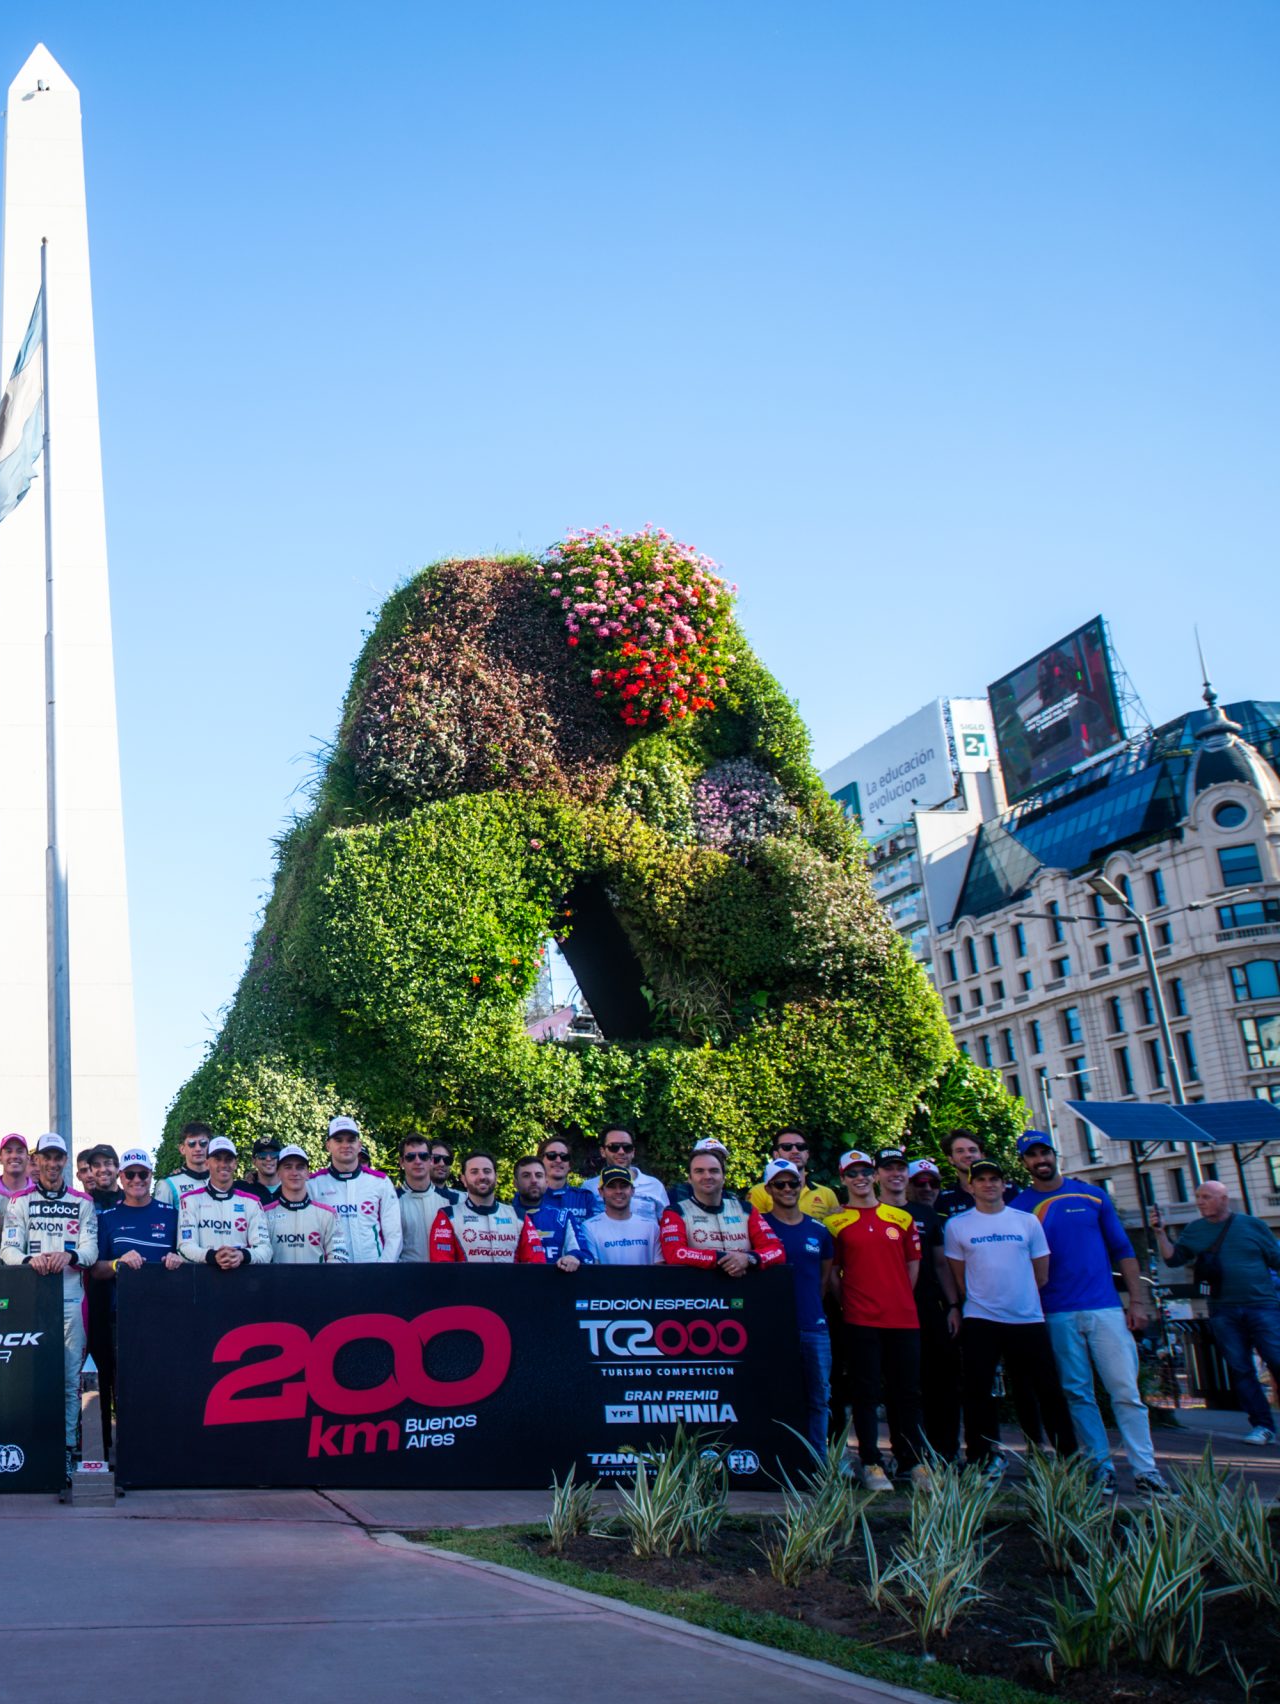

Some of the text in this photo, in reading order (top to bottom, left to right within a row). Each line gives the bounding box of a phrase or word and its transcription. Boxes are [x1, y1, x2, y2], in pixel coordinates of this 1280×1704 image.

[966, 736, 987, 757] 21
[866, 748, 935, 796] La educación
[869, 772, 927, 814] evoluciona
[123, 1153, 147, 1162] Mobil
[41, 1204, 79, 1216] addoc
[28, 1221, 63, 1232] AXION
[479, 1233, 516, 1241] SAN JUAN
[604, 1238, 649, 1248] eurofarma
[709, 1233, 728, 1241] SAN
[970, 1232, 1024, 1245] eurofarma
[589, 1298, 729, 1311] EDICIÓN ESPECIAL
[579, 1319, 748, 1357] TC2000
[203, 1305, 512, 1426] 200
[601, 1366, 735, 1377] TURISMO COMPETICIÓN
[624, 1389, 719, 1401] GRAN PREMIO
[611, 1403, 739, 1424] YPF INFINIA
[405, 1414, 478, 1433] Buenos
[307, 1415, 401, 1458] km
